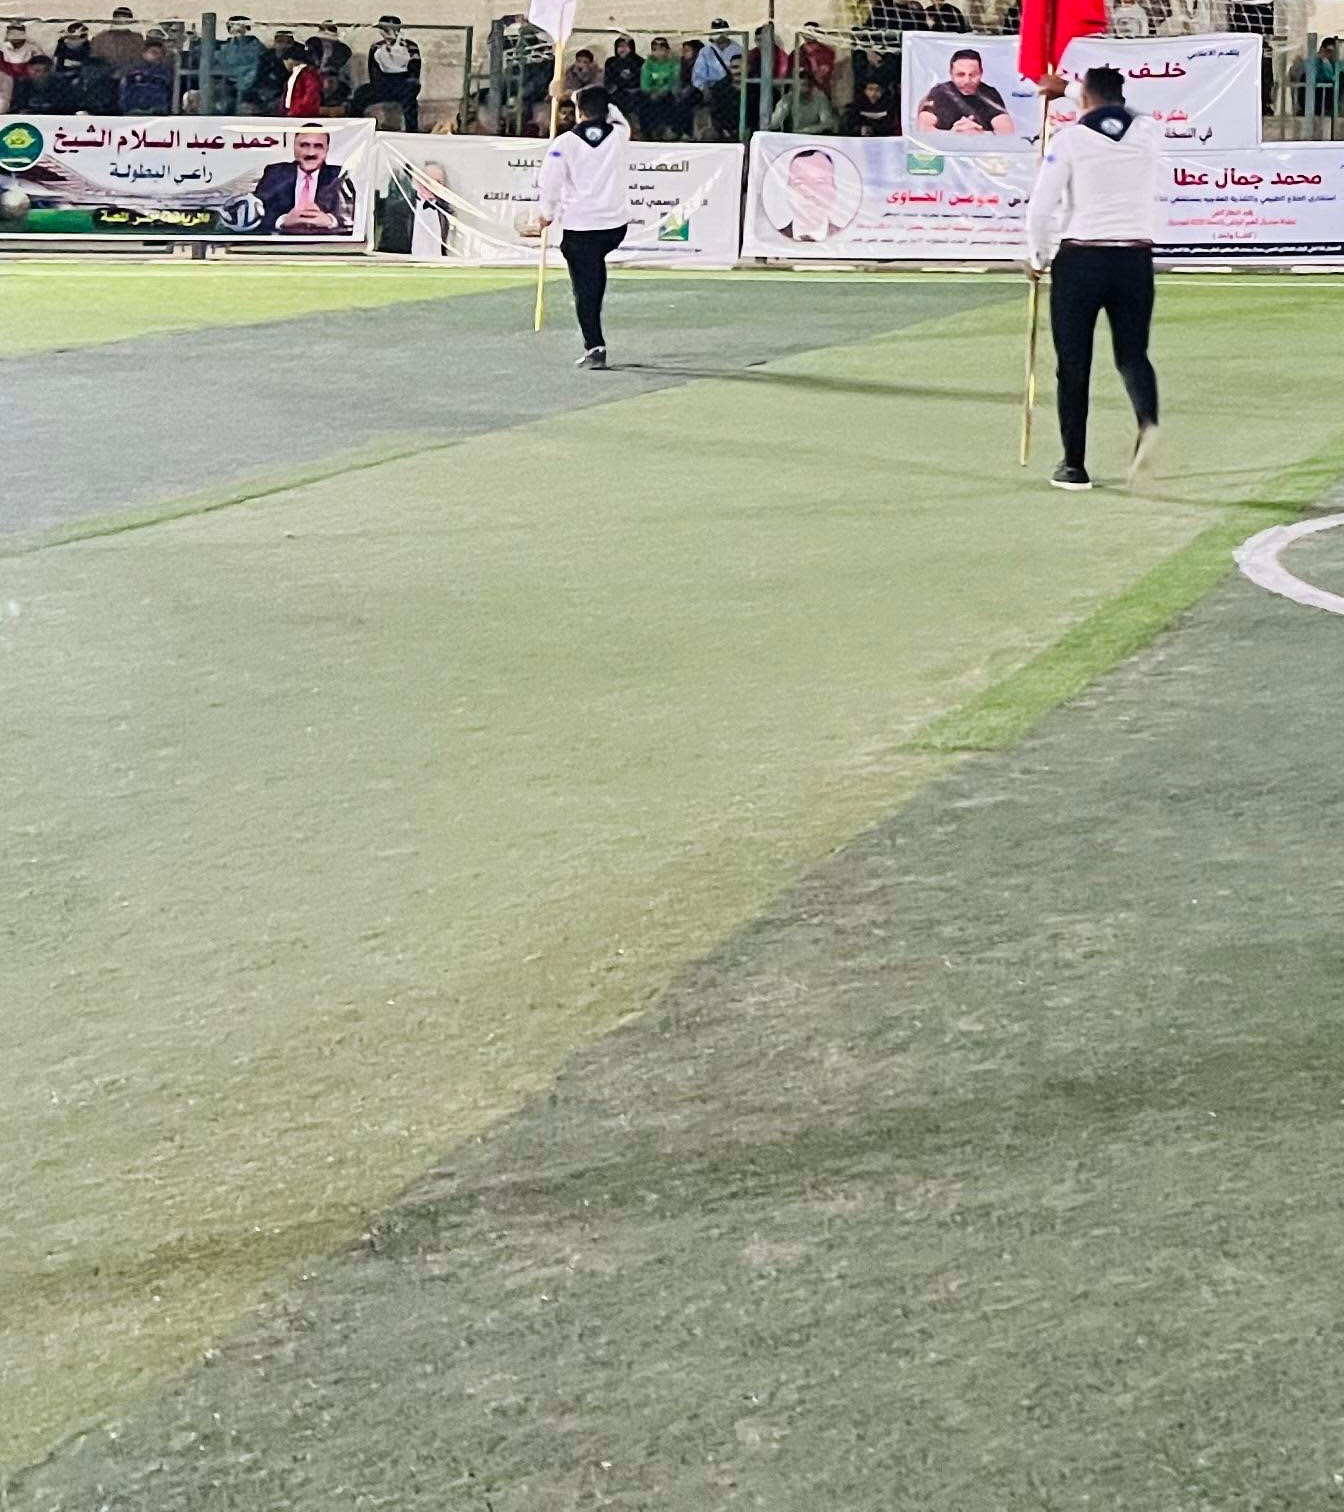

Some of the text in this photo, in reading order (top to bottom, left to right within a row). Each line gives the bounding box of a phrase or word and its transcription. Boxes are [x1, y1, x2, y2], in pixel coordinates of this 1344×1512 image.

[1128, 62, 1187, 79] خلف
[53, 124, 112, 154] الشيخ
[117, 128, 181, 155] السلام
[186, 132, 226, 155] عبد
[109, 161, 171, 184] البطولة
[1173, 168, 1322, 189] محمد جمال عطا
